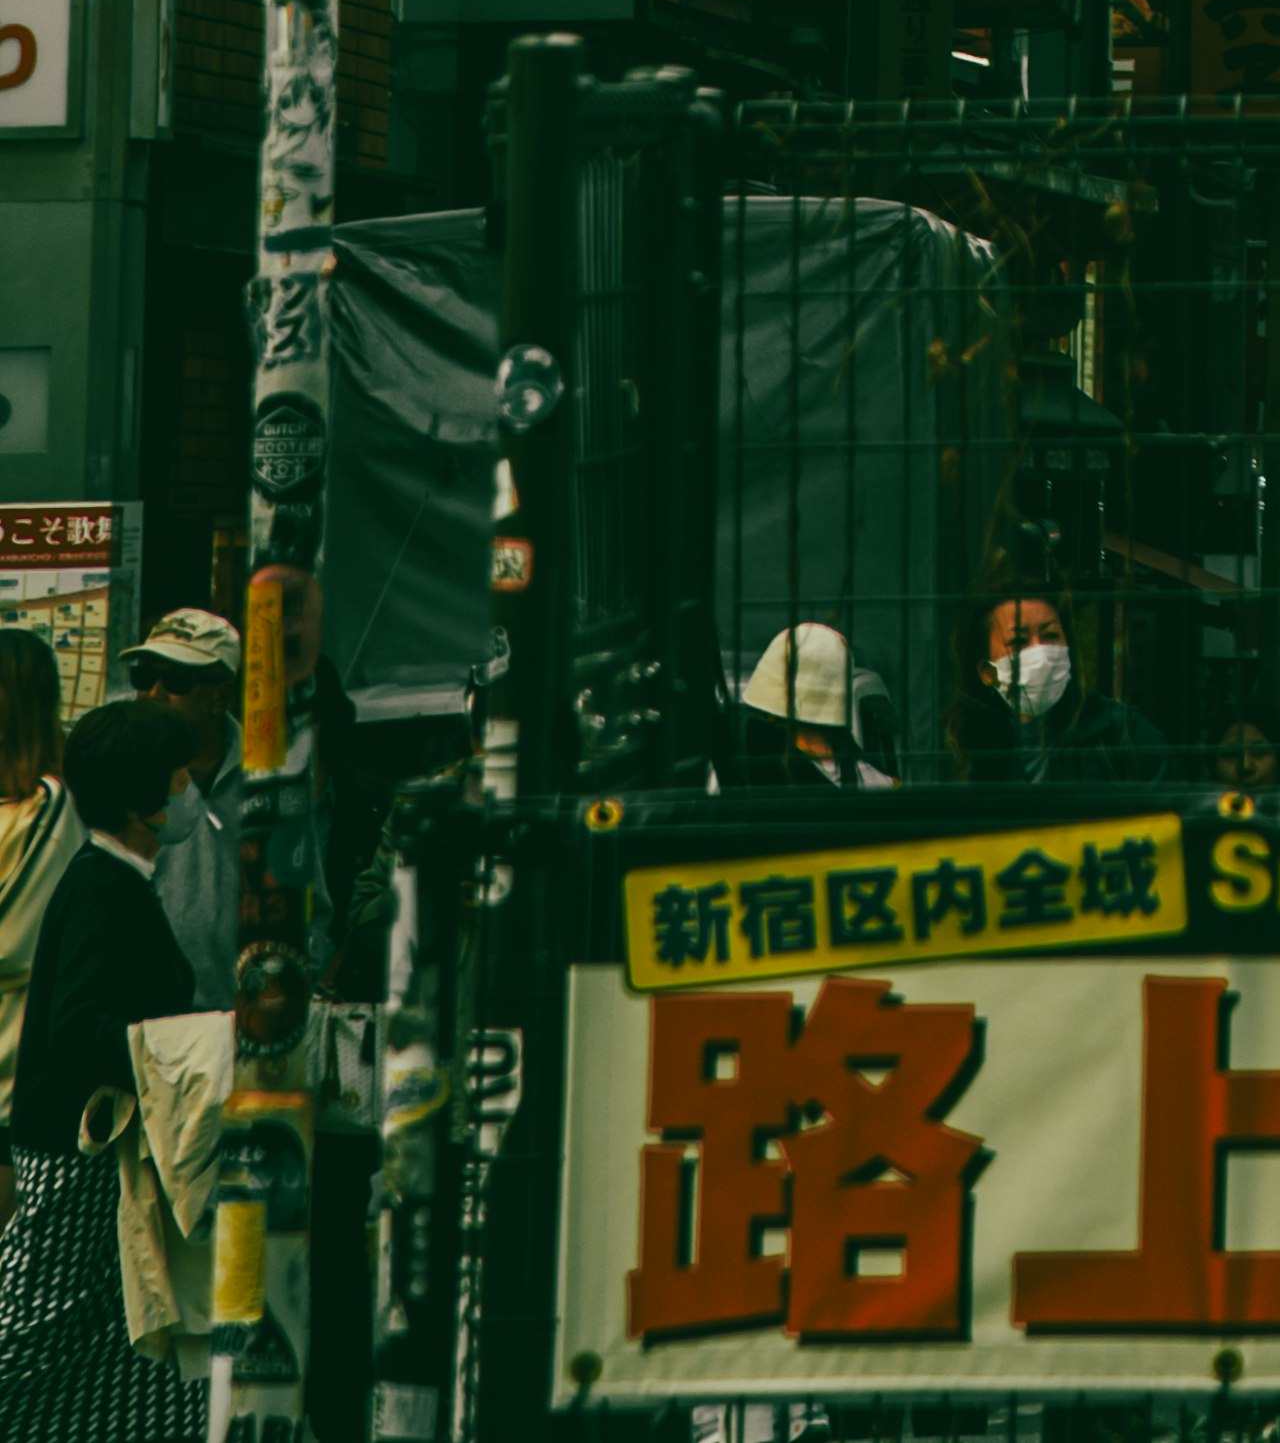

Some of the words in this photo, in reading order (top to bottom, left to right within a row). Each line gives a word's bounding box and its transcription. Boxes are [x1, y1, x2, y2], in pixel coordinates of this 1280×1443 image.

[650, 838, 1163, 970] 新宿区内全域
